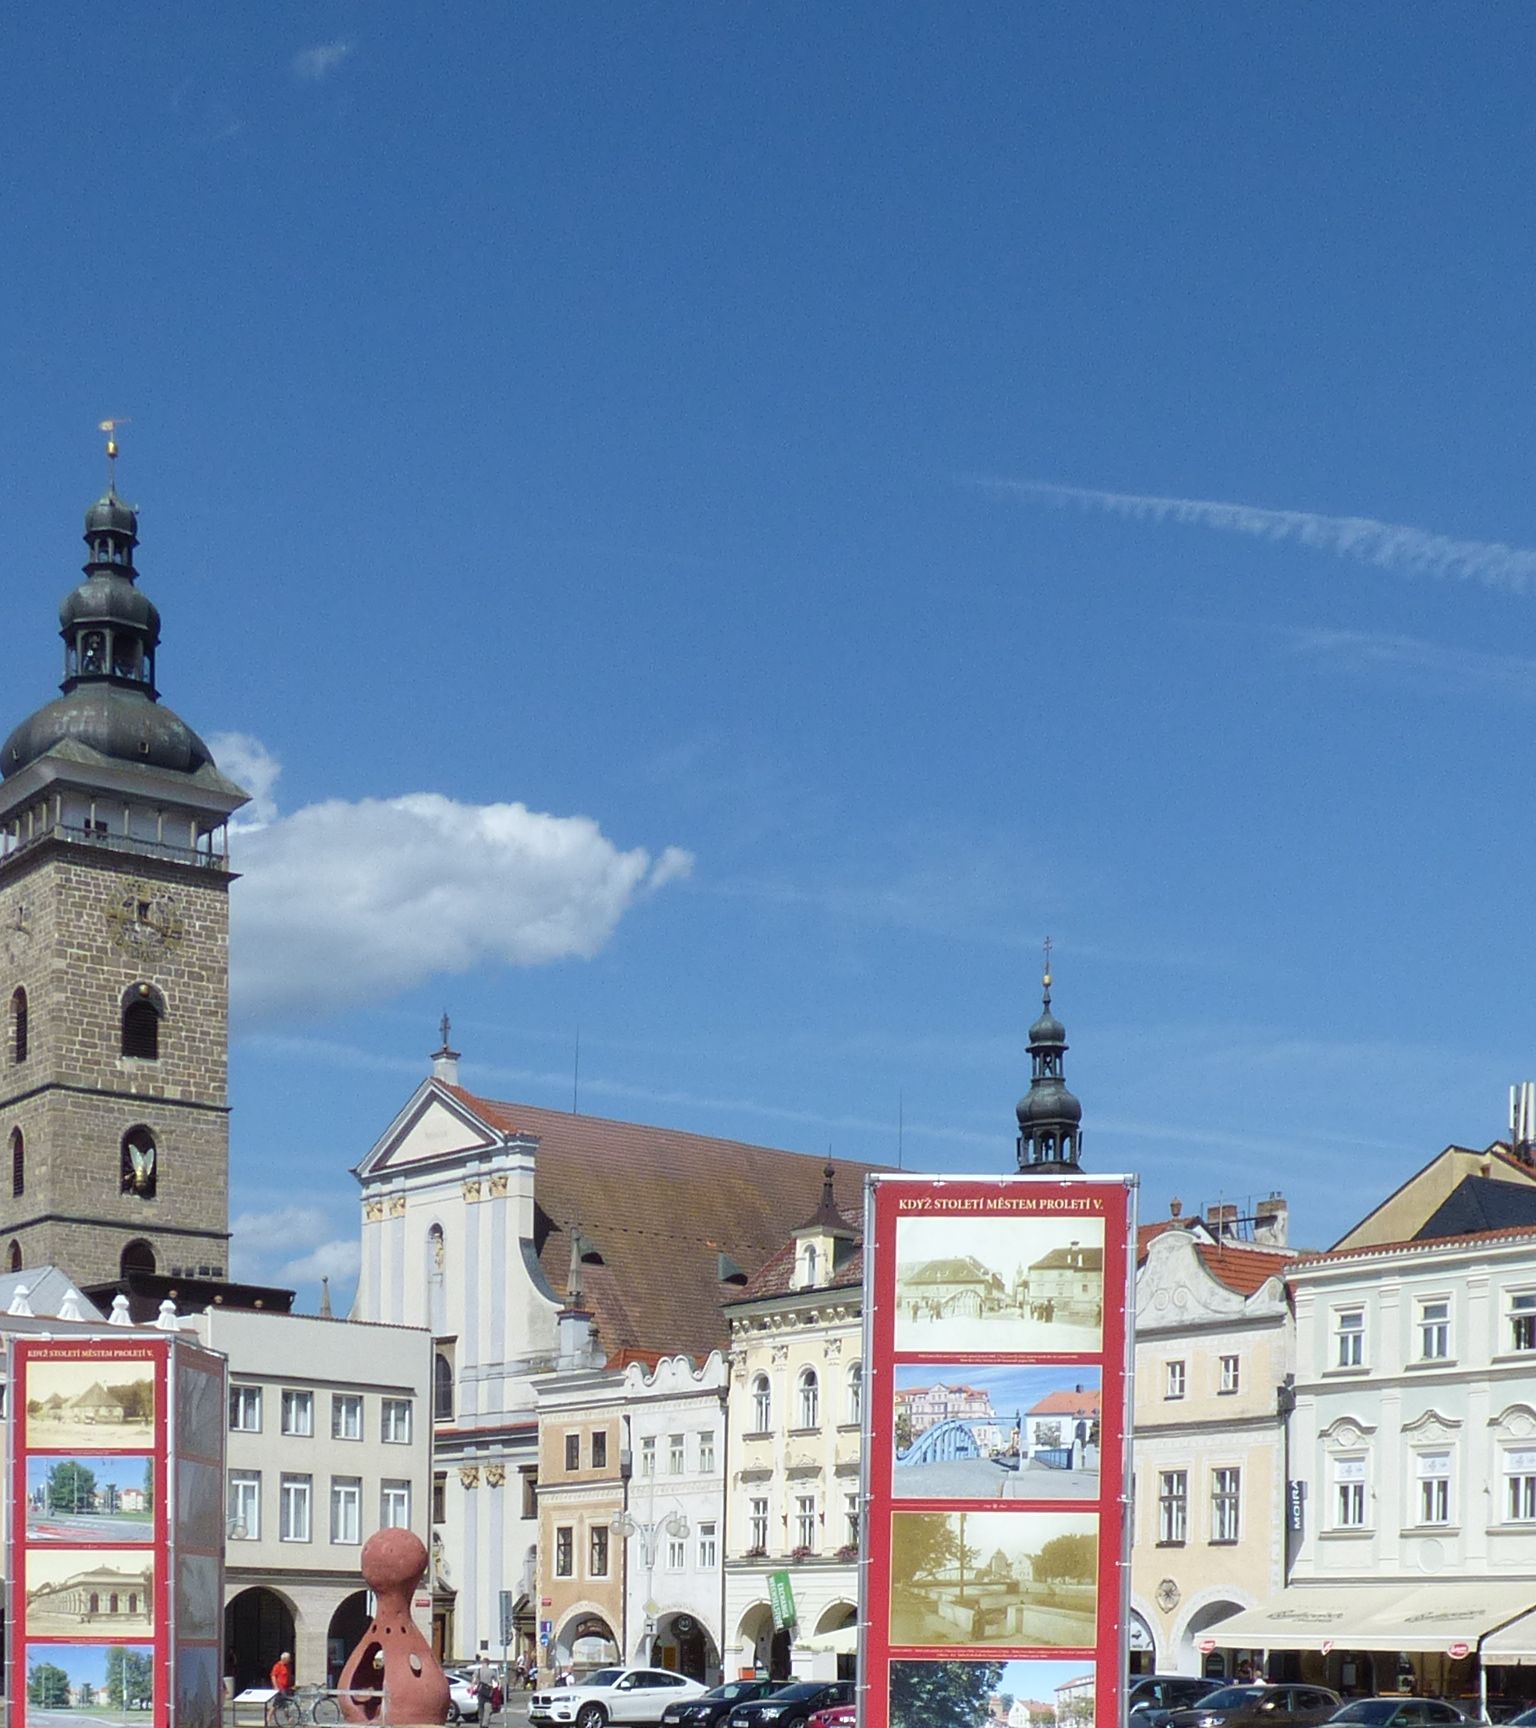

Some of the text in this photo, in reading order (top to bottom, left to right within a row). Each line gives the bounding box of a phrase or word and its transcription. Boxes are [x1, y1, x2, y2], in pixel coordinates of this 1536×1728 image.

[899, 1196, 1104, 1210] KDYŽ STOLETÍ MĚSTEM PROLETÍ V.
[27, 1348, 48, 1358] KDYŽ
[48, 1348, 80, 1358] STOLETÍ
[81, 1348, 113, 1358] MĚSTEM
[113, 1348, 145, 1358] PROLETÍ
[1292, 1479, 1301, 1530] MOIRA
